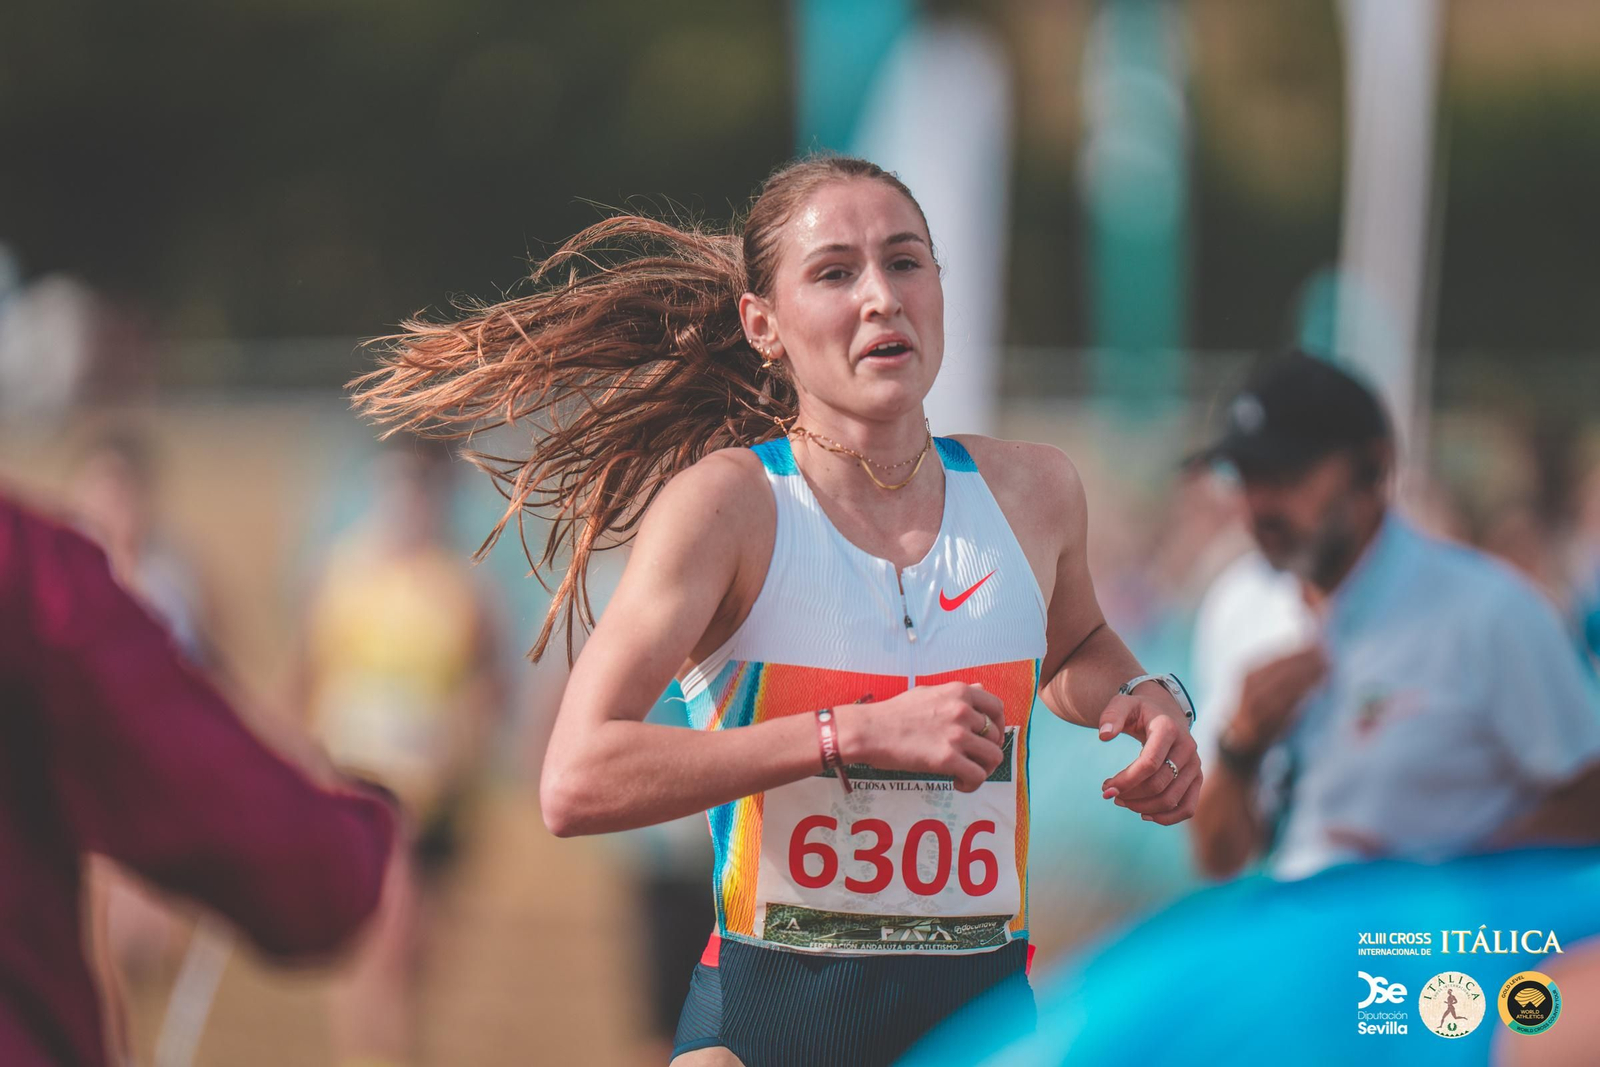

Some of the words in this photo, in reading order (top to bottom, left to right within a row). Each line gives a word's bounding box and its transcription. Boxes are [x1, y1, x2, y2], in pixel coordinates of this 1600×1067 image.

[889, 782, 923, 792] VILLA,
[925, 780, 954, 791] MARÍ
[788, 814, 999, 897] 6306
[809, 941, 858, 950] FEDERACIÓN
[860, 942, 903, 950] ANDALUZA
